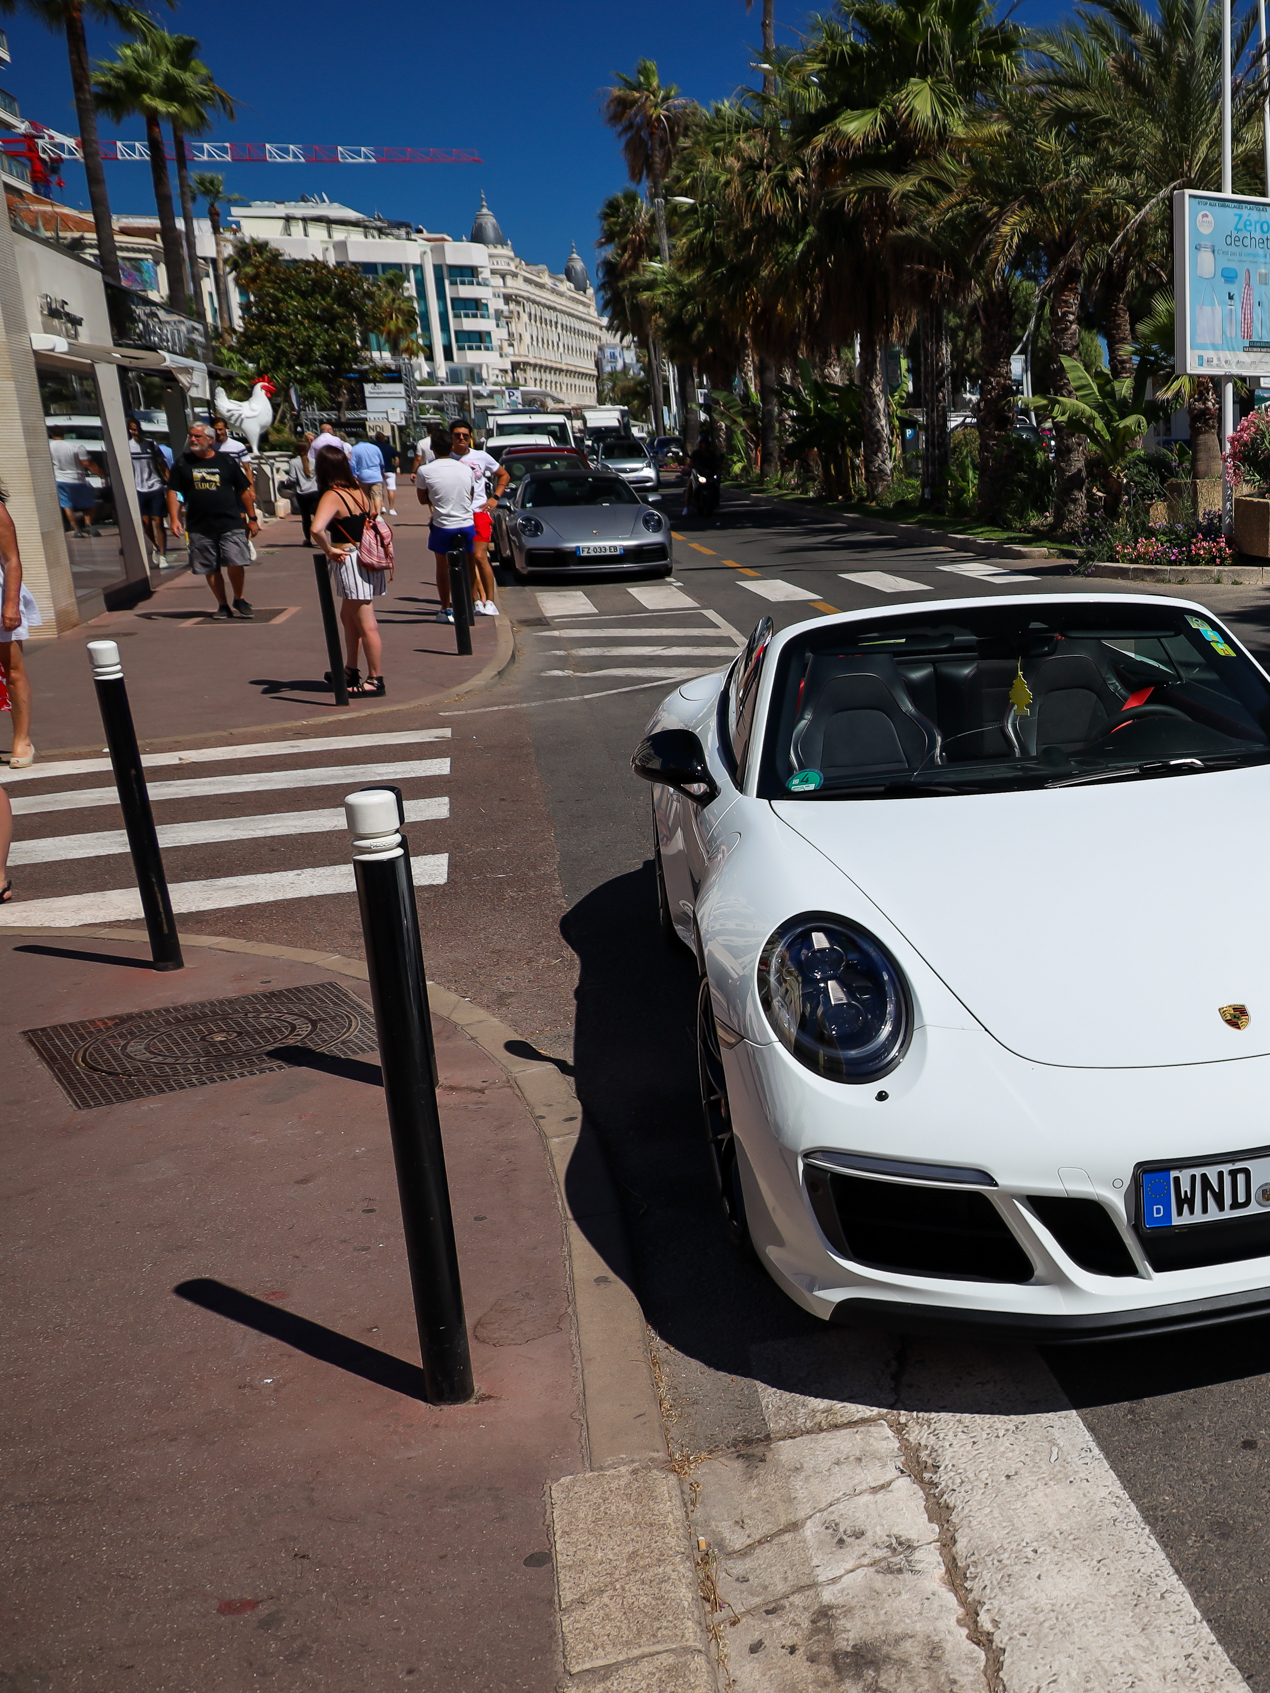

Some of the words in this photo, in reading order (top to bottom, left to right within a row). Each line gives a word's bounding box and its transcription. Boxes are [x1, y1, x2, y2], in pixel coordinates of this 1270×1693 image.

[1233, 213, 1270, 234] Zéro
[1225, 230, 1270, 250] déchet
[508, 390, 515, 399] P
[801, 773, 809, 784] 4
[1172, 1166, 1252, 1217] WND
[1153, 1205, 1164, 1217] D
